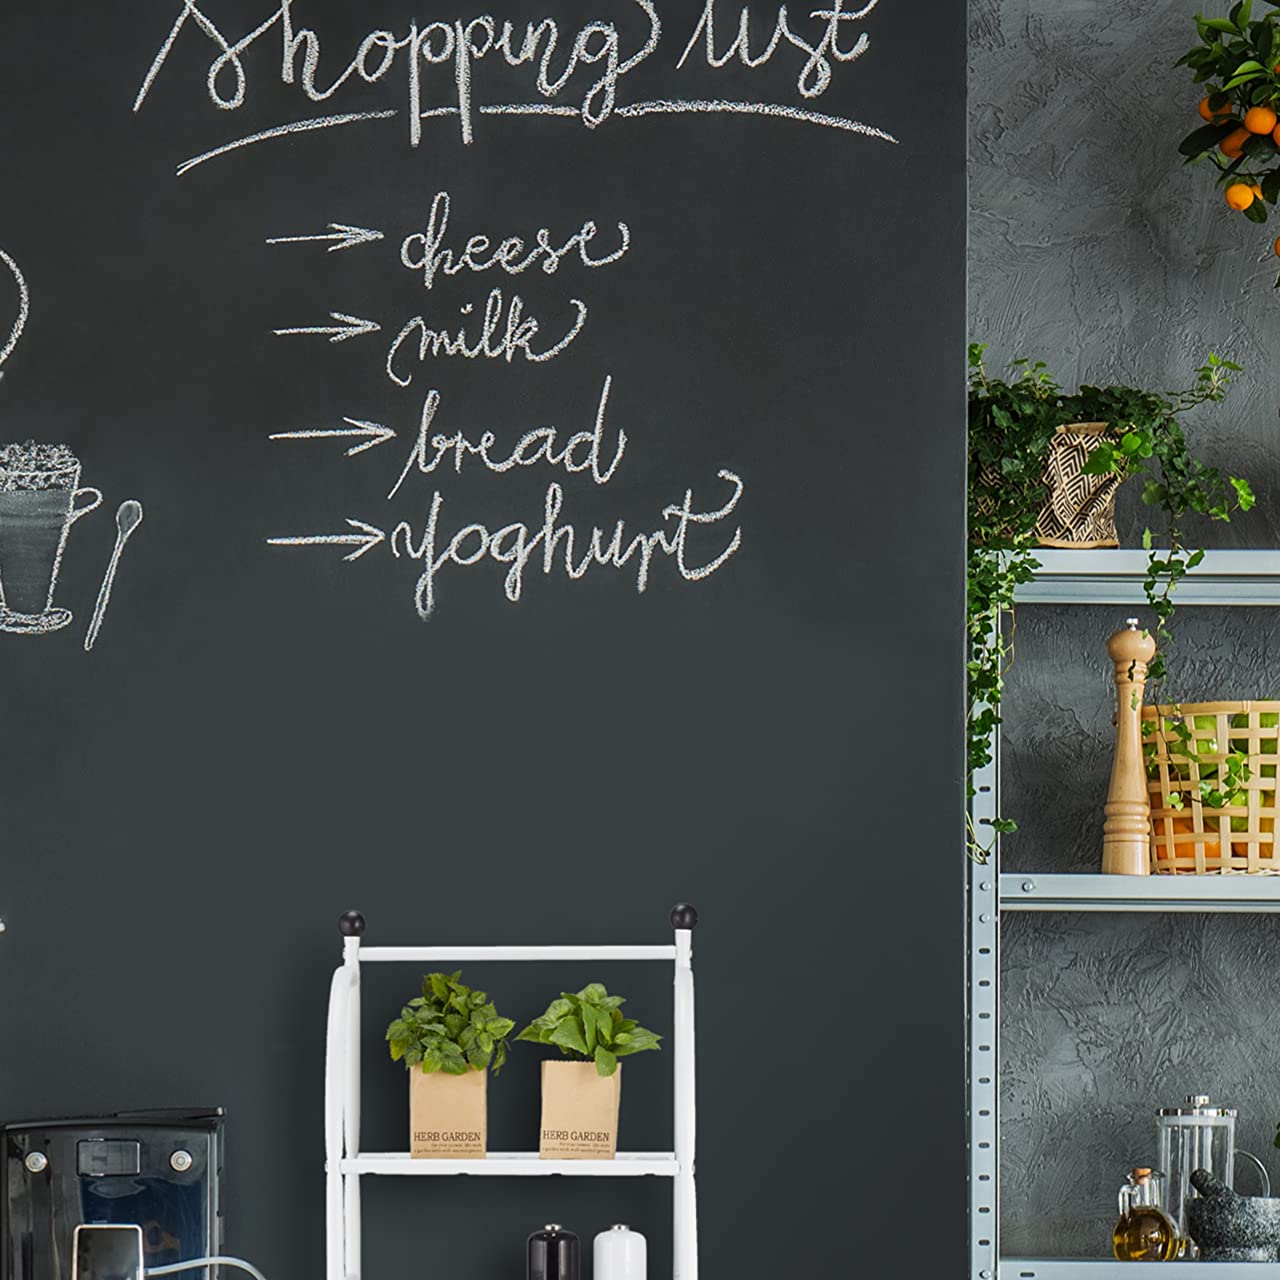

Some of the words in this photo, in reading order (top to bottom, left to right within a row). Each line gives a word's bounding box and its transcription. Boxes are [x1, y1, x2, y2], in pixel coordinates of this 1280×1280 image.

[400, 191, 630, 290] cheese
[386, 287, 588, 387] milk
[388, 375, 628, 500] bread
[413, 1131, 440, 1142] HERB
[441, 1131, 481, 1142] GARDEN
[543, 1130, 569, 1141] HERB
[570, 1131, 610, 1143] GARDEN
